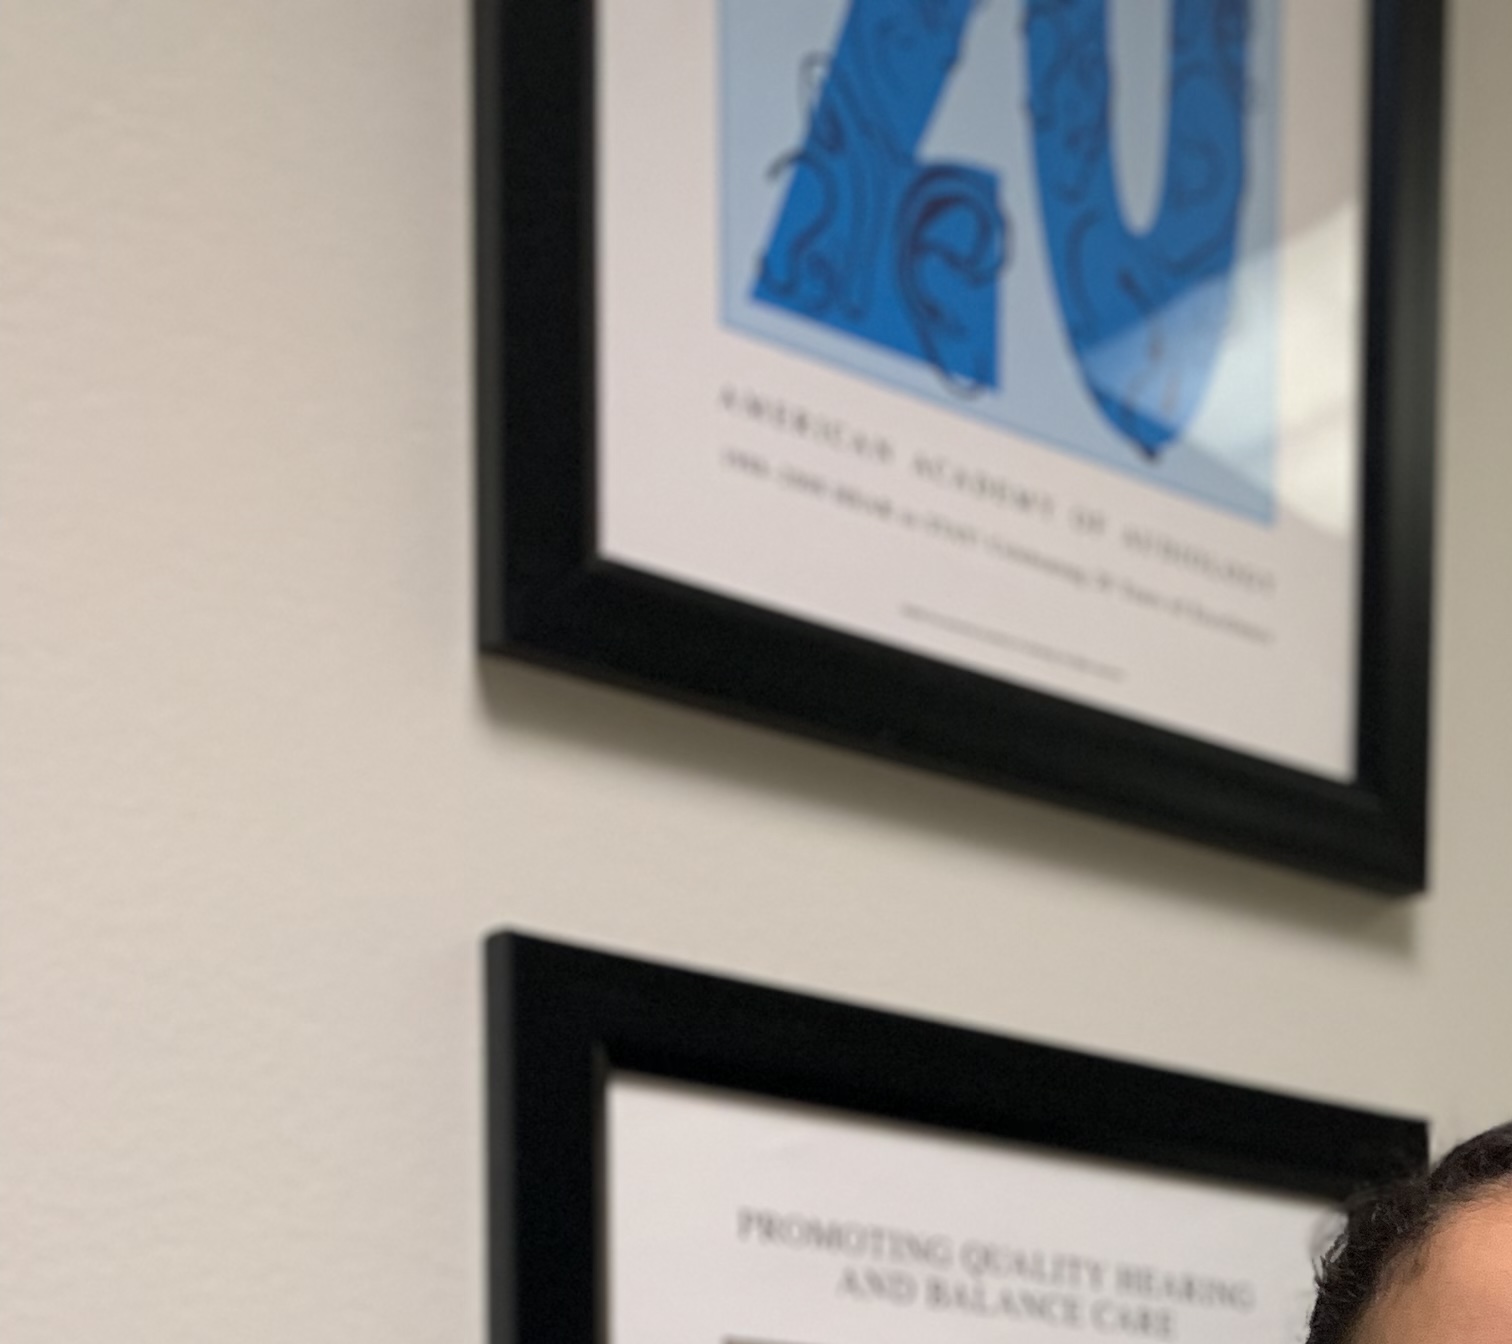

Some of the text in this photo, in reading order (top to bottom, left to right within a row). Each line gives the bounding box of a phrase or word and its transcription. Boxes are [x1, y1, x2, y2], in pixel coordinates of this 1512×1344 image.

[736, 1207, 1257, 1313] PROMOTING QUALITY HEARING
[834, 1267, 1177, 1341] AND BALANCE CARE
